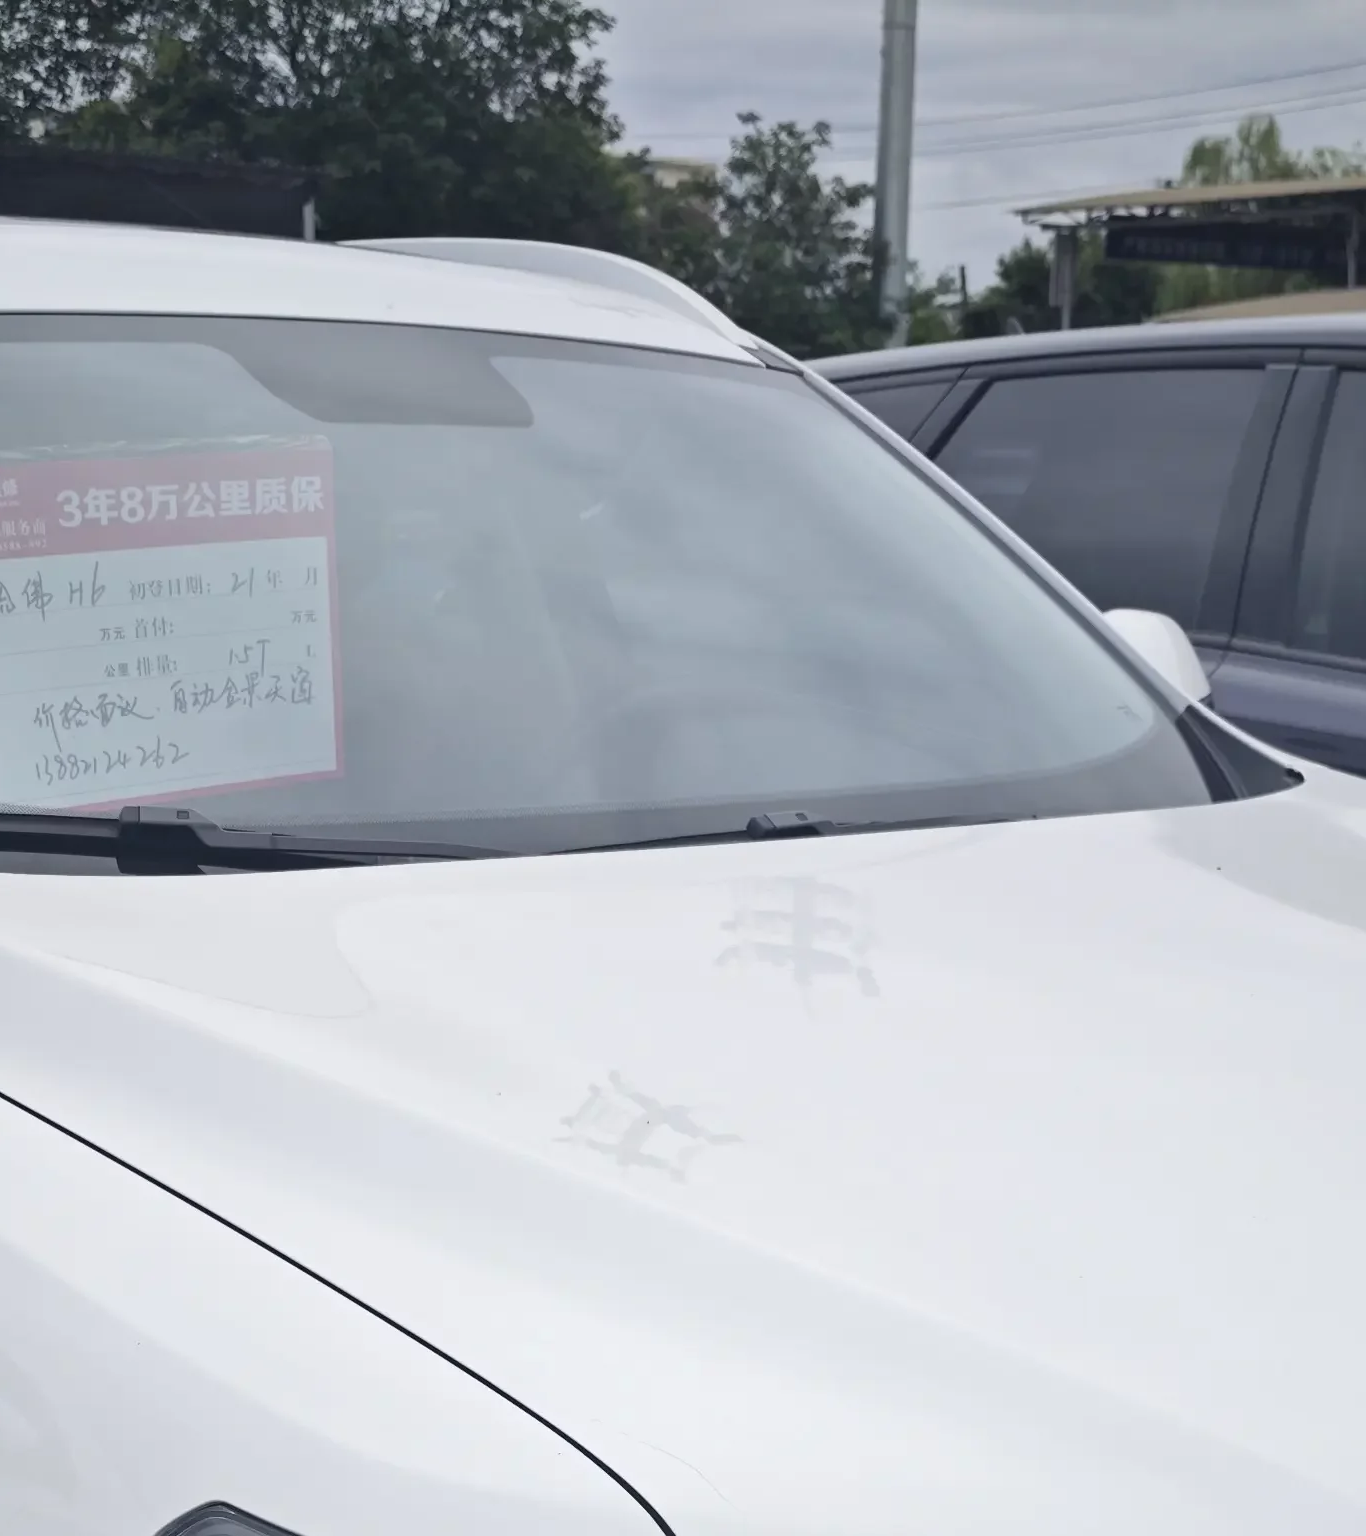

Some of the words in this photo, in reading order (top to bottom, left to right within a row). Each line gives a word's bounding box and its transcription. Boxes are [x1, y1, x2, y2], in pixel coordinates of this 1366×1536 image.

[55, 476, 325, 528] 3年8万公里质保
[290, 608, 318, 624] 万元
[99, 626, 127, 641] 万元
[103, 662, 130, 678] 公里
